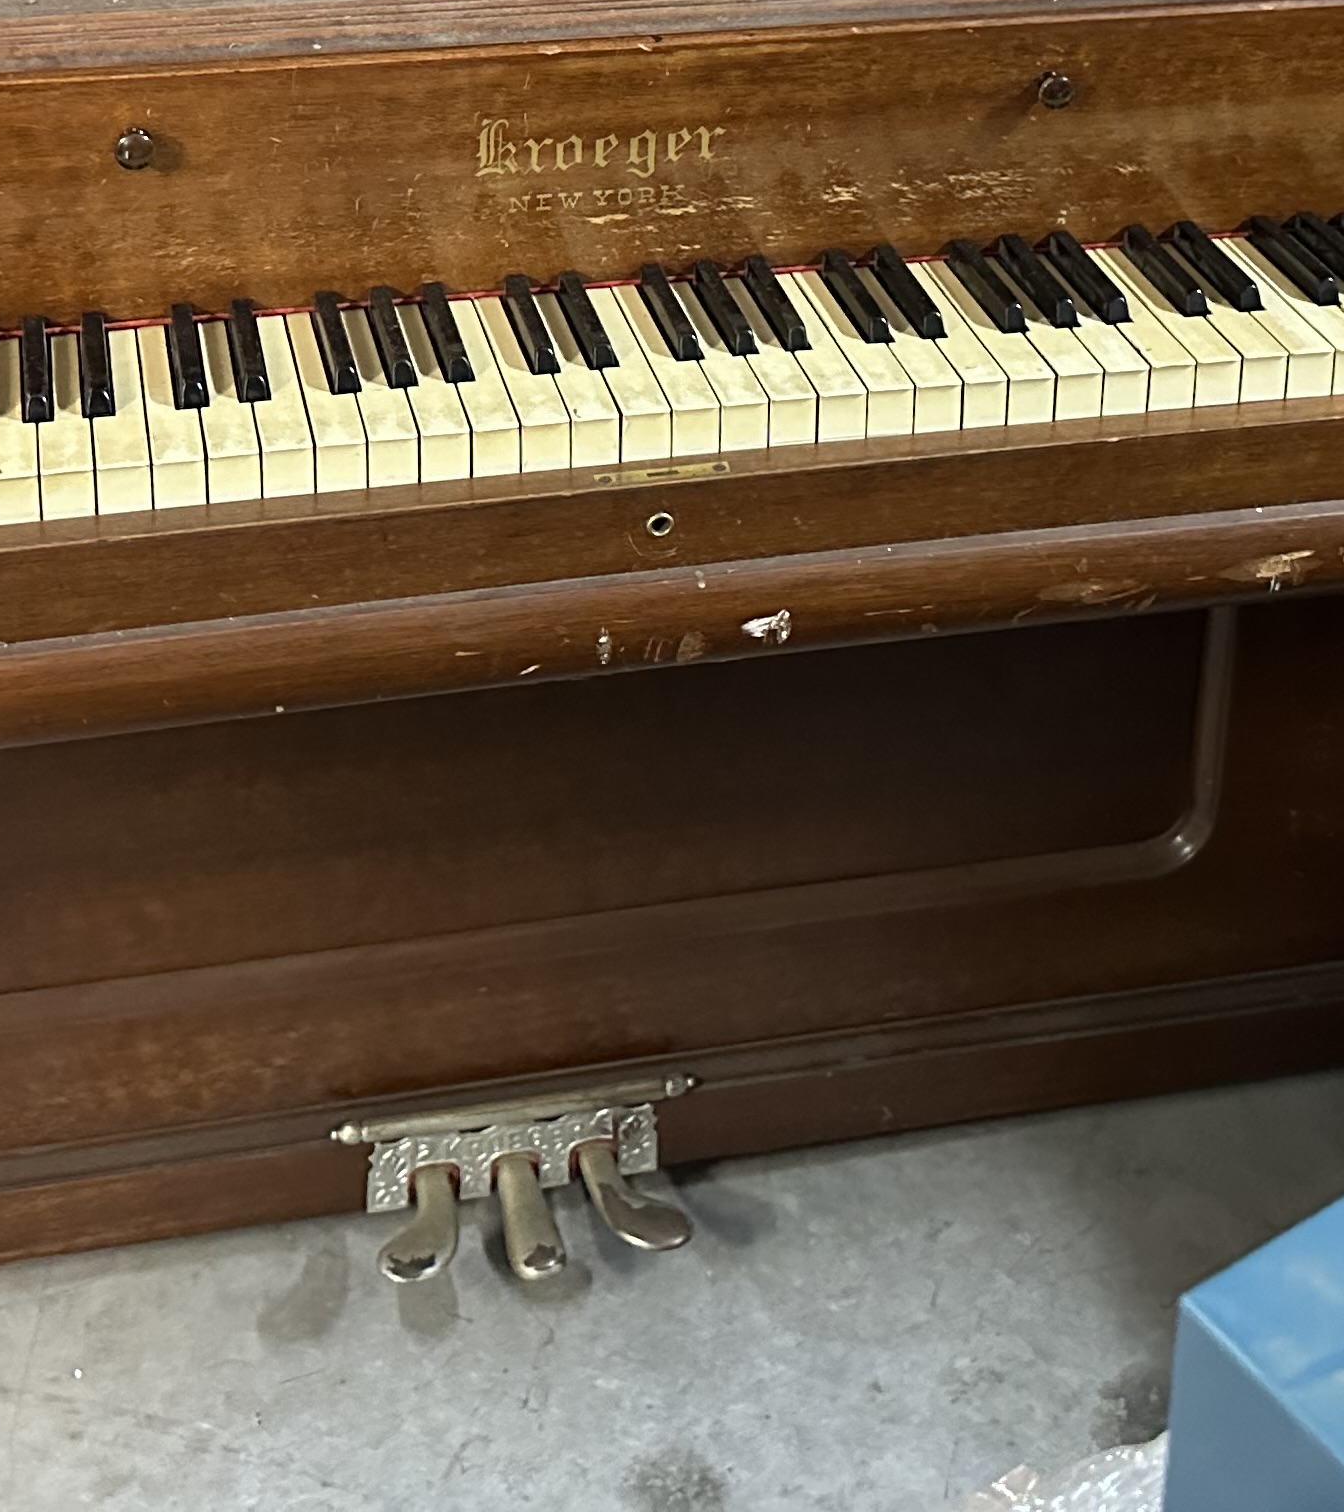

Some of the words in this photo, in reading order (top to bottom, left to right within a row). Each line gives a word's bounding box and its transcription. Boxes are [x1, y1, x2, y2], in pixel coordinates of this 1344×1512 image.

[475, 119, 727, 178] Kroeger
[508, 192, 583, 213] NEW
[592, 184, 685, 206] YORK
